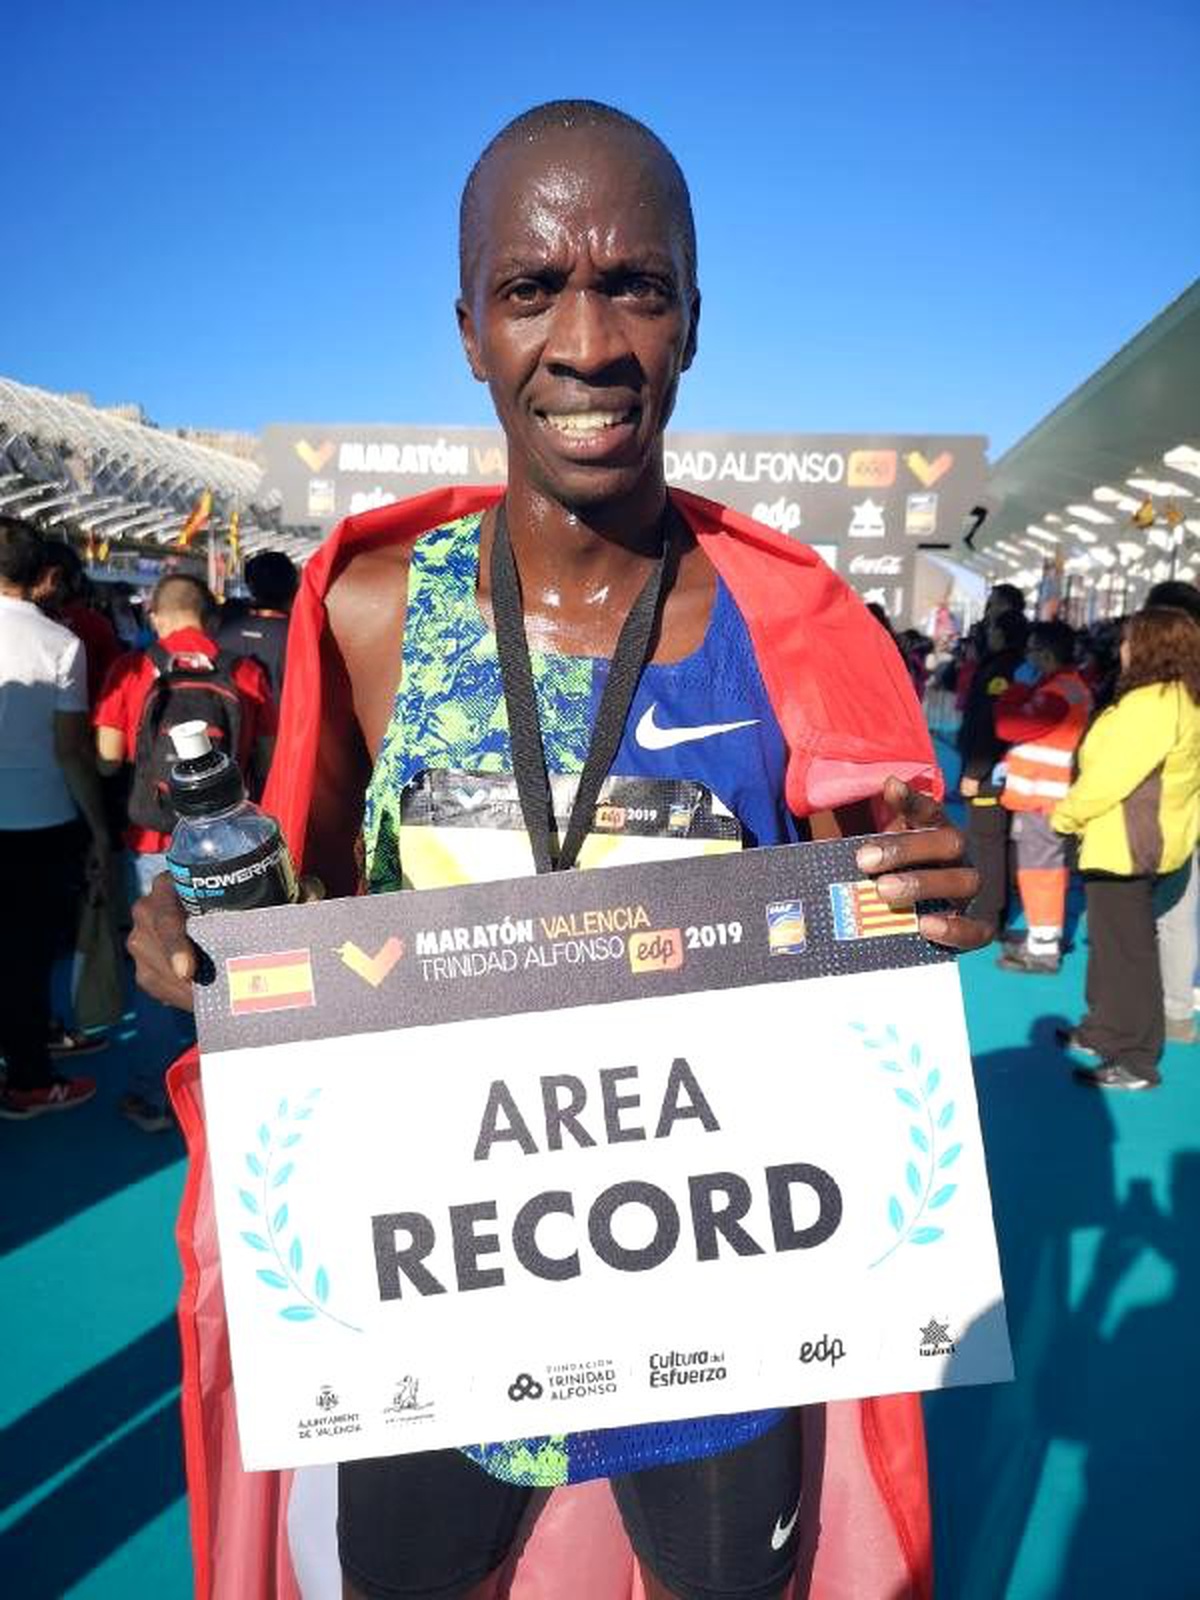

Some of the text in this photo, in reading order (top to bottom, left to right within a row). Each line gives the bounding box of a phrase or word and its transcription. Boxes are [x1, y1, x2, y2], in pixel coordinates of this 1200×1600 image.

[339, 439, 469, 475] MARATÓN
[719, 450, 844, 484] ALFONSO
[627, 808, 657, 821] 2019
[415, 904, 650, 954] MARATÓN VALENCIA
[420, 921, 743, 981] TRINIDAD ALFONSO edp 2019
[474, 1057, 720, 1161] AREA
[371, 1162, 843, 1302] RECORD
[649, 1350, 709, 1371] Cultura
[798, 1334, 846, 1367] edp
[549, 1369, 616, 1388] TRINIDAD
[550, 1383, 617, 1401] ALFONSO
[649, 1366, 727, 1389] Esfuerzo
